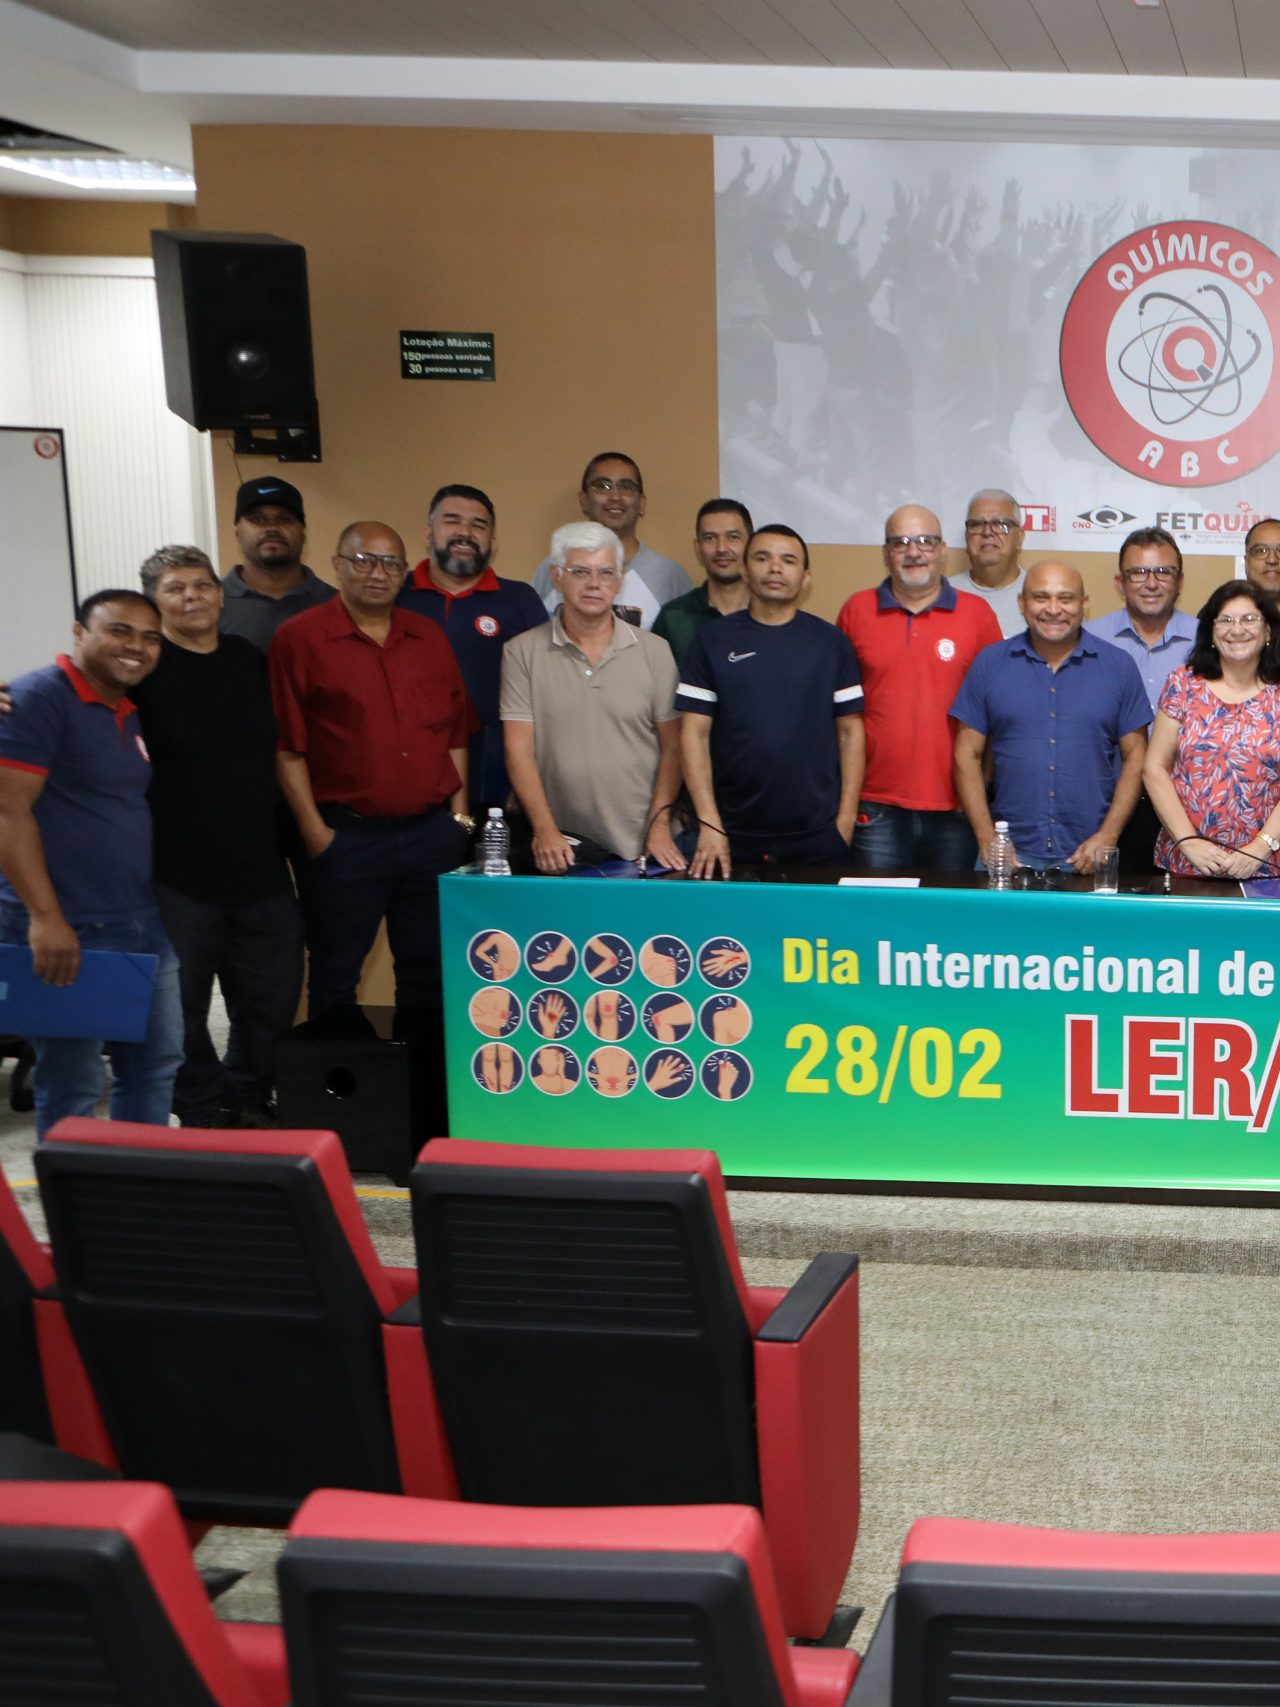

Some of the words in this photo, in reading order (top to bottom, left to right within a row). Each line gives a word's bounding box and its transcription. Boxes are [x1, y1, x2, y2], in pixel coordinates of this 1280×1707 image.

[1107, 229, 1274, 296] QUÍMICOS
[403, 337, 445, 348] Lotação
[447, 337, 491, 349] Máxima:
[455, 354, 491, 362] sentadas
[409, 363, 423, 374] 30
[425, 366, 457, 374] pessoas
[473, 366, 484, 375] pé
[1072, 521, 1091, 529] CNQ
[783, 938, 860, 985] Dia
[878, 940, 1199, 994] Internacional
[1218, 950, 1275, 997] de
[785, 1023, 1002, 1104] 28/02
